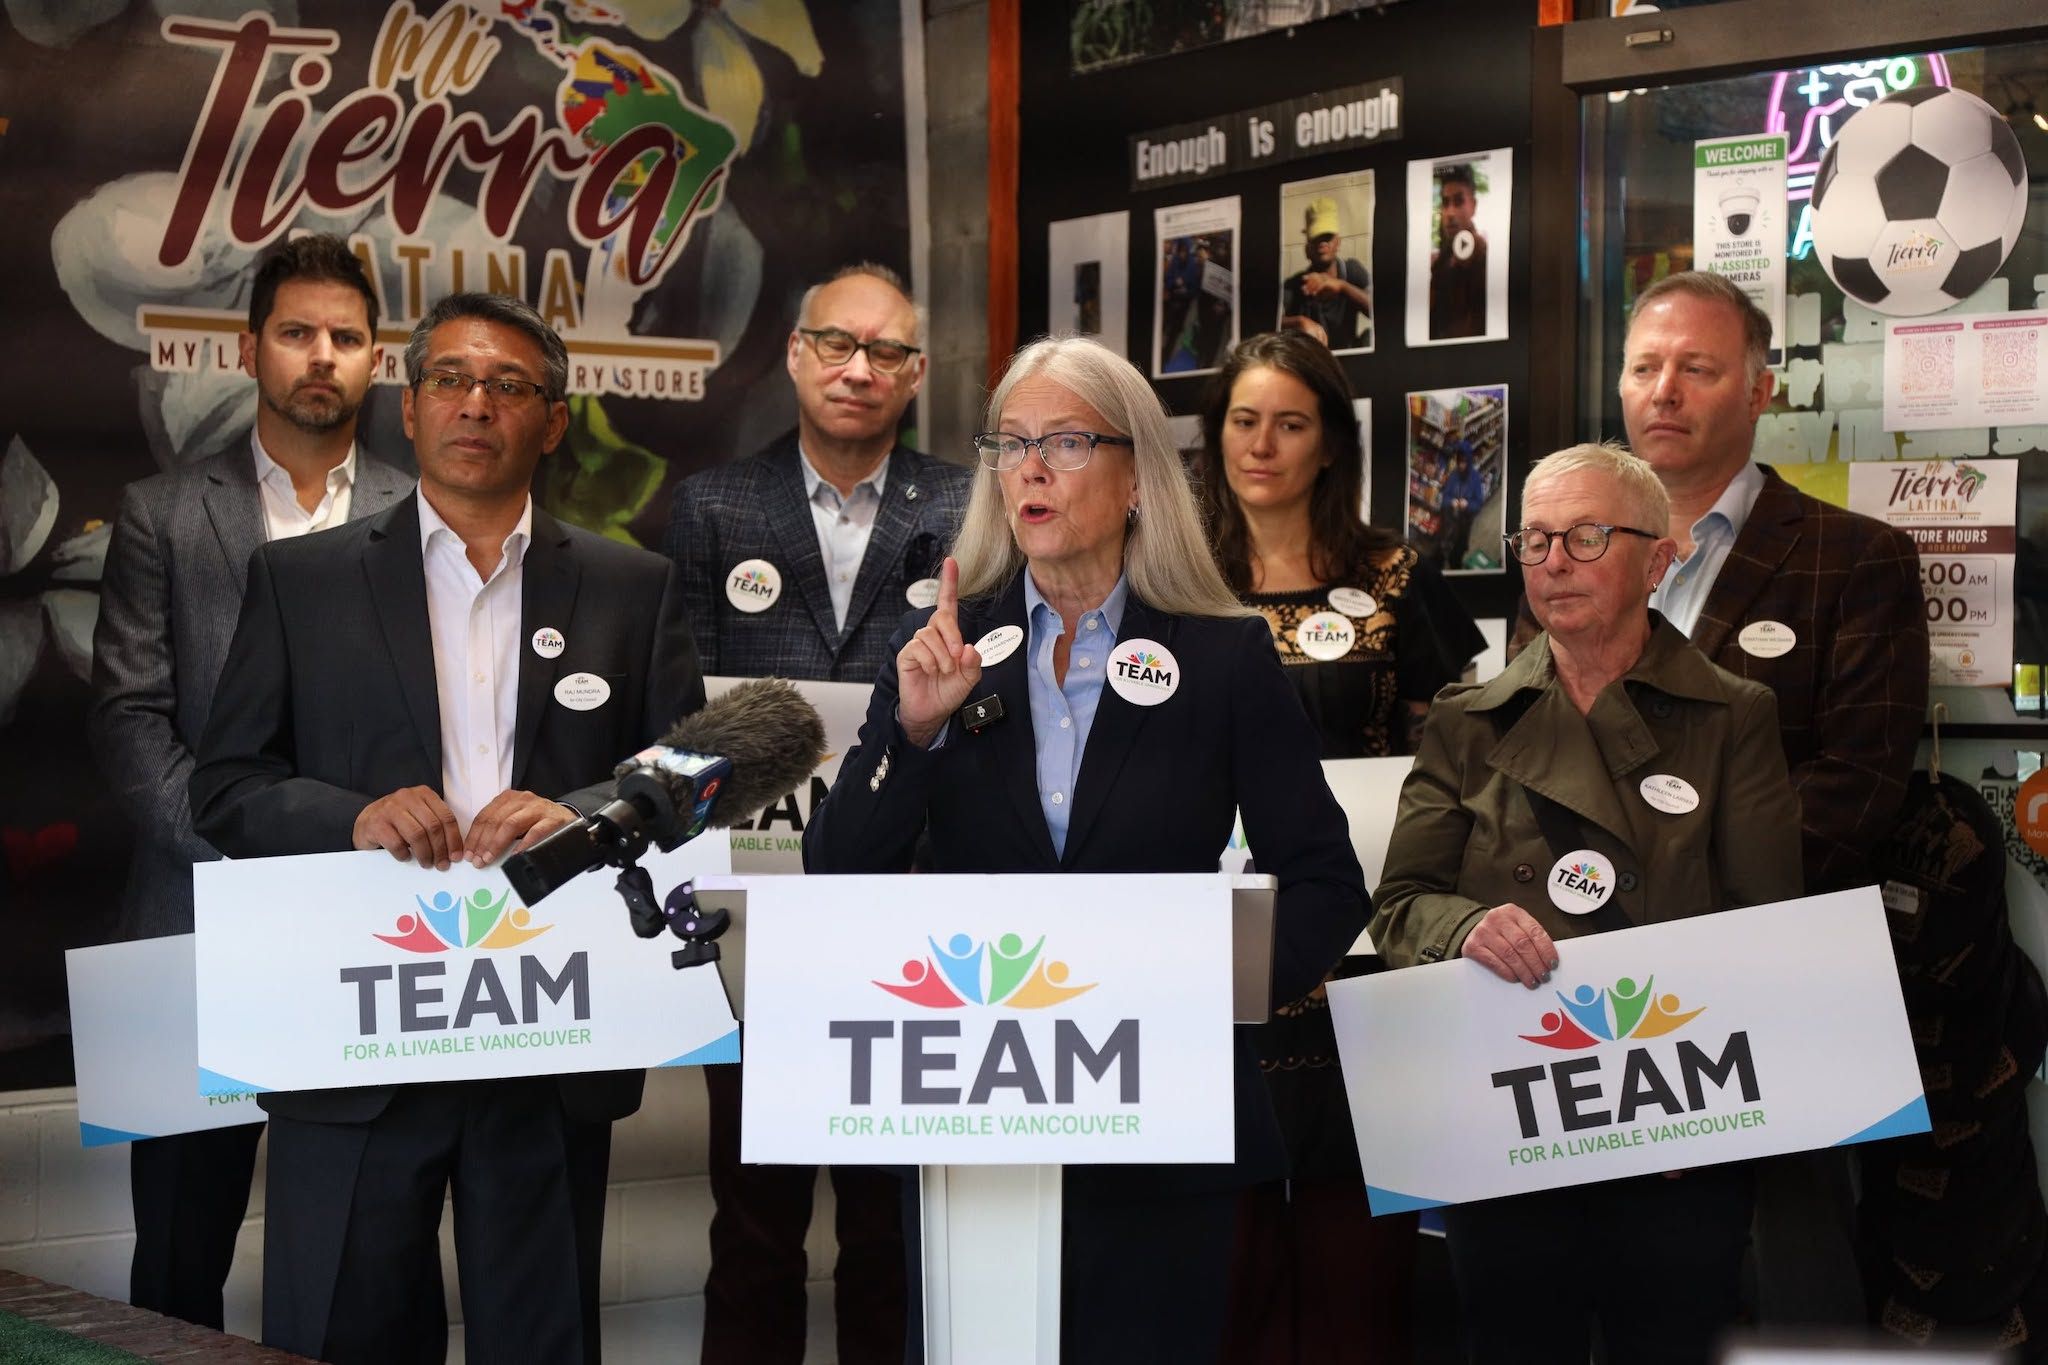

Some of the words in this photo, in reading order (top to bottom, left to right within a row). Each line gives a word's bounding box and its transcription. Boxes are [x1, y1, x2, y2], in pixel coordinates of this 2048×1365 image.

[376, 0, 498, 98] Mi
[1136, 126, 1227, 181] Enough
[1249, 117, 1275, 158] is
[1296, 88, 1399, 148] enough
[158, 18, 724, 287] Tierra
[1705, 142, 1777, 165] WELCOME!
[1715, 249, 1752, 259] MONITORED
[1754, 249, 1762, 257] BY
[1716, 242, 1731, 250] THIS
[1732, 240, 1752, 249] STORE
[1707, 257, 1770, 274] AI-ASSISTED
[159, 341, 196, 367] MY
[622, 368, 700, 394] STORE
[1888, 467, 1978, 507] Tierra
[1909, 499, 1957, 512] LATINA
[1947, 530, 1988, 543] HOURS
[734, 576, 773, 599] TEAM
[1968, 575, 1988, 586] AM
[1970, 610, 1987, 621] PM
[536, 638, 562, 648] TEAM
[987, 633, 1002, 642] TEAM
[1306, 631, 1348, 642] TEAM
[1116, 661, 1171, 687] TEAM
[1557, 868, 1606, 900] TEAM
[340, 951, 591, 1036] TEAM
[344, 1043, 379, 1060] FOR
[384, 1042, 397, 1058] A
[401, 1036, 475, 1057] LIVABLE
[480, 1028, 592, 1051] VANCOUVER
[829, 1019, 1140, 1105] TEAM
[1491, 1031, 1761, 1139] TEAM
[829, 1115, 874, 1136] FOR
[880, 1115, 896, 1136] A
[902, 1115, 993, 1136] LIVABLE
[1000, 1114, 1140, 1136] VANCOUVER
[1508, 1144, 1547, 1166] FOR
[1551, 1142, 1564, 1159] A
[1568, 1129, 1648, 1157] LIVABLE
[1648, 1109, 1767, 1143] VANCOUVER
